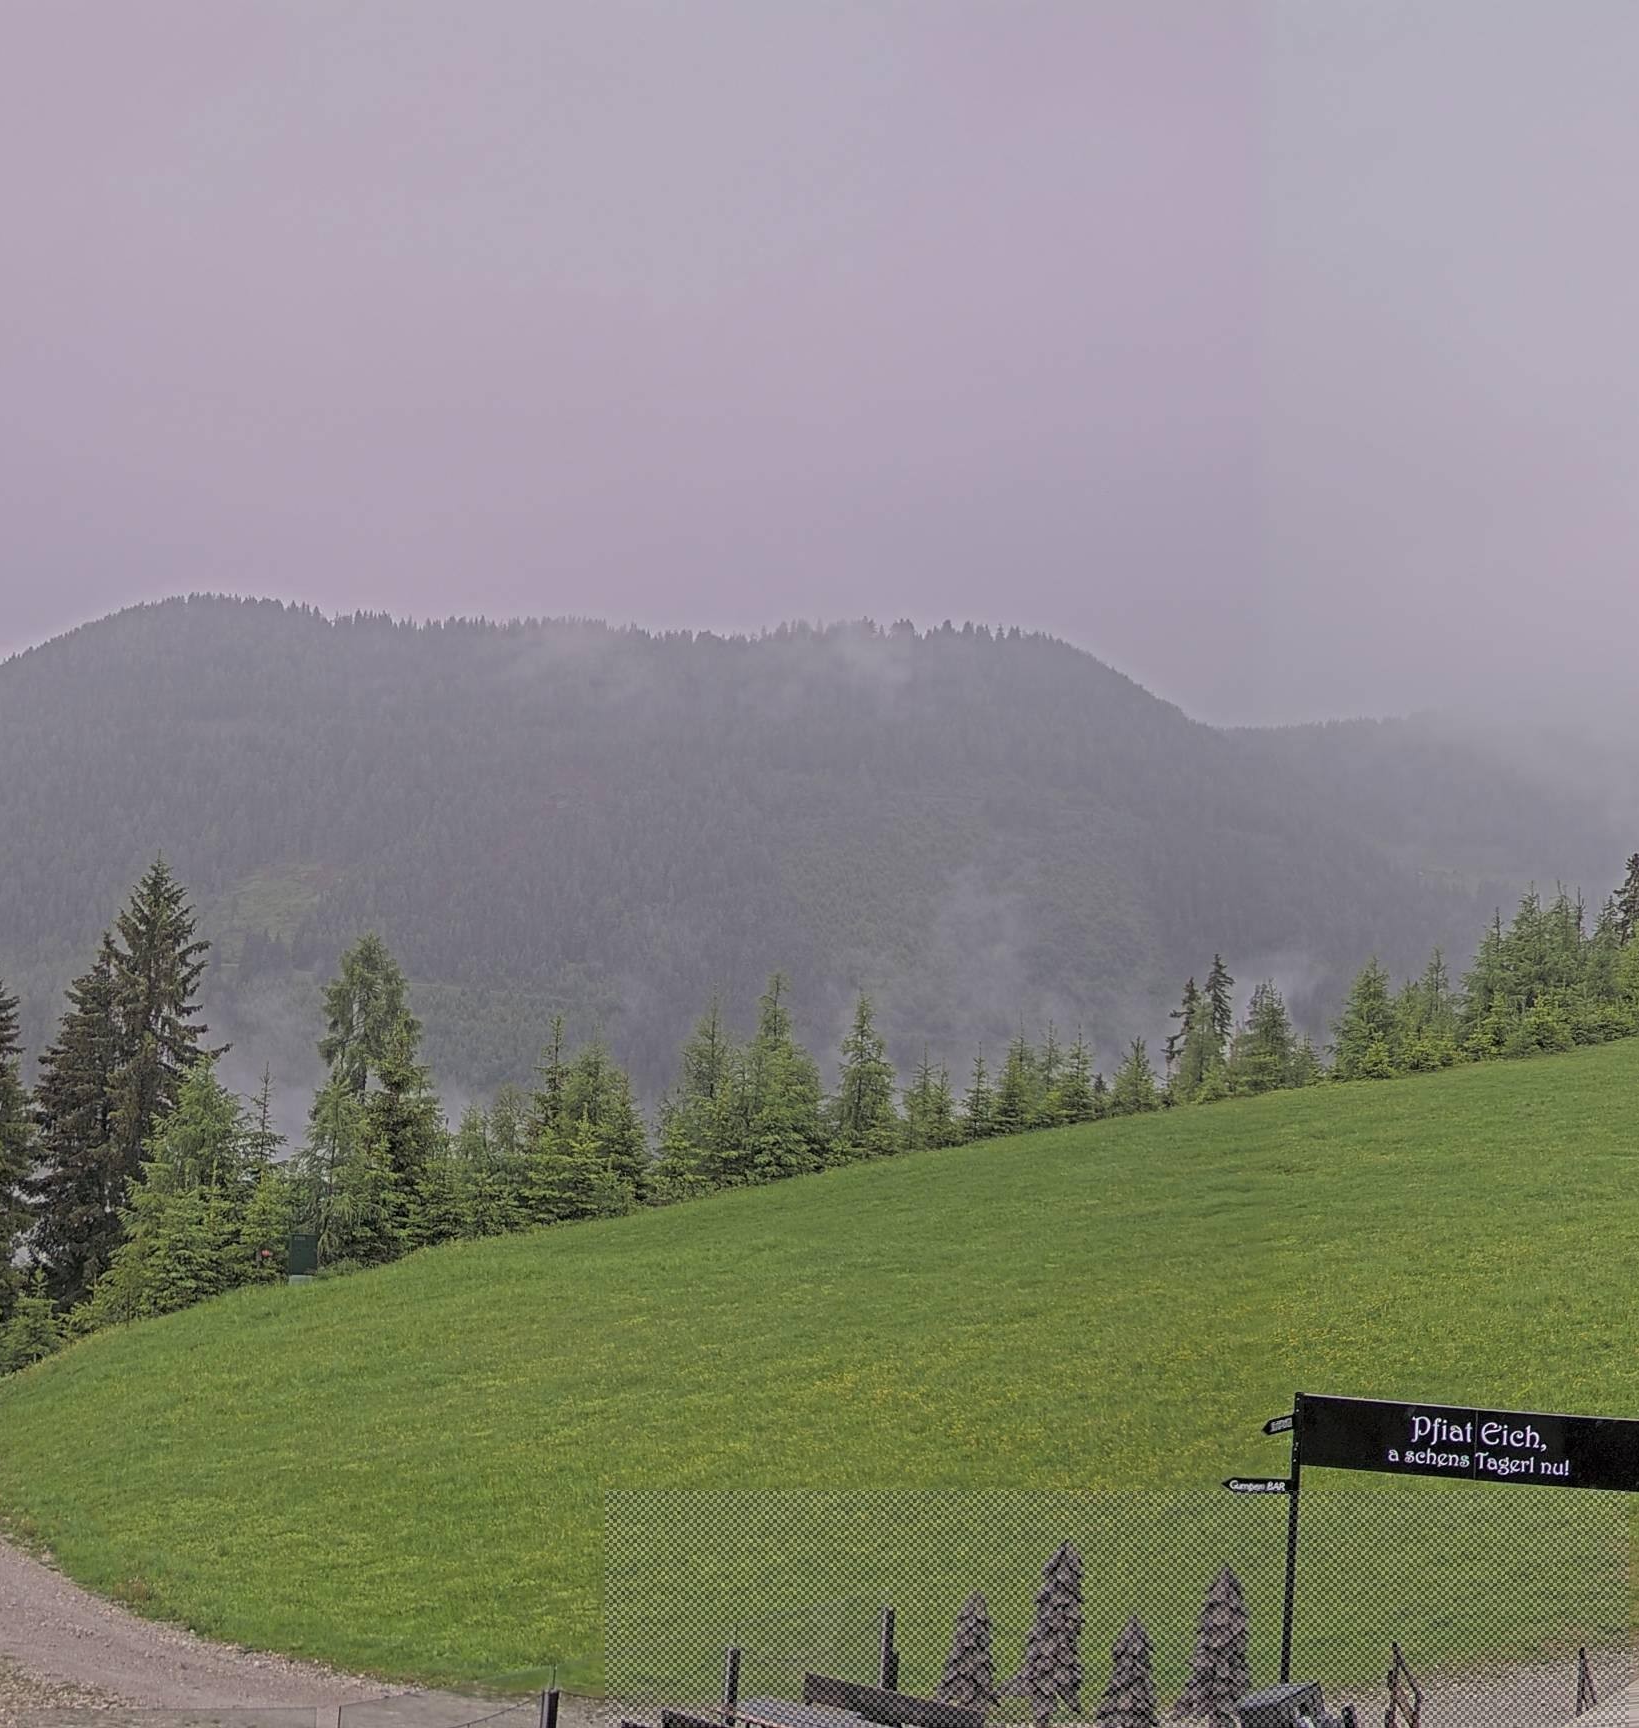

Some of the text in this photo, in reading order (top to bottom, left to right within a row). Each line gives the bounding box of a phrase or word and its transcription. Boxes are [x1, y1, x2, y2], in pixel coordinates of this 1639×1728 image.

[1411, 1416, 1547, 1452] Pfiat Eich,
[1388, 1448, 1570, 1476] a schens Tagerl nu!
[1267, 1481, 1285, 1491] BAR
